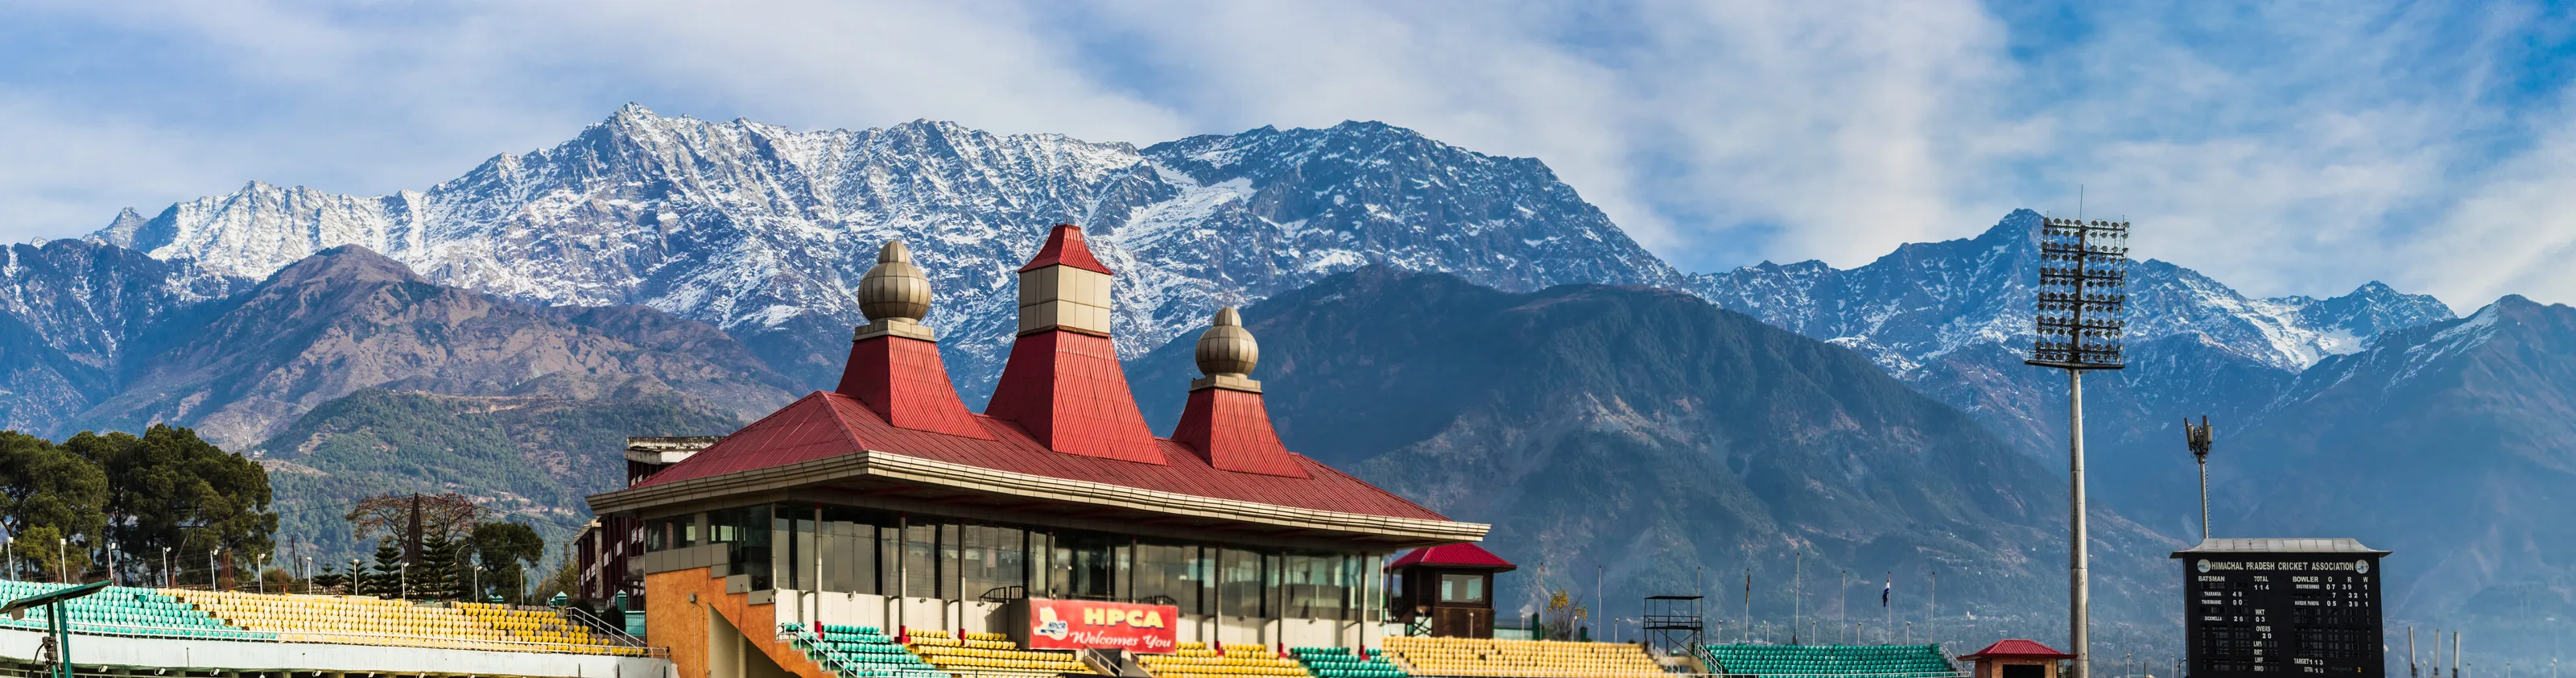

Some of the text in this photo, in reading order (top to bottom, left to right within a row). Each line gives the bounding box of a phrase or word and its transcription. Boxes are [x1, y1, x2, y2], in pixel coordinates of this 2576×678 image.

[2211, 561, 2244, 570] HIMACHAL
[2246, 562, 2275, 570] PRADESH
[2278, 561, 2308, 571] CRICKET
[2311, 562, 2354, 571] ASSOCIATION
[1084, 607, 1165, 629] HPCA
[1069, 630, 1171, 648] Welcomes You
